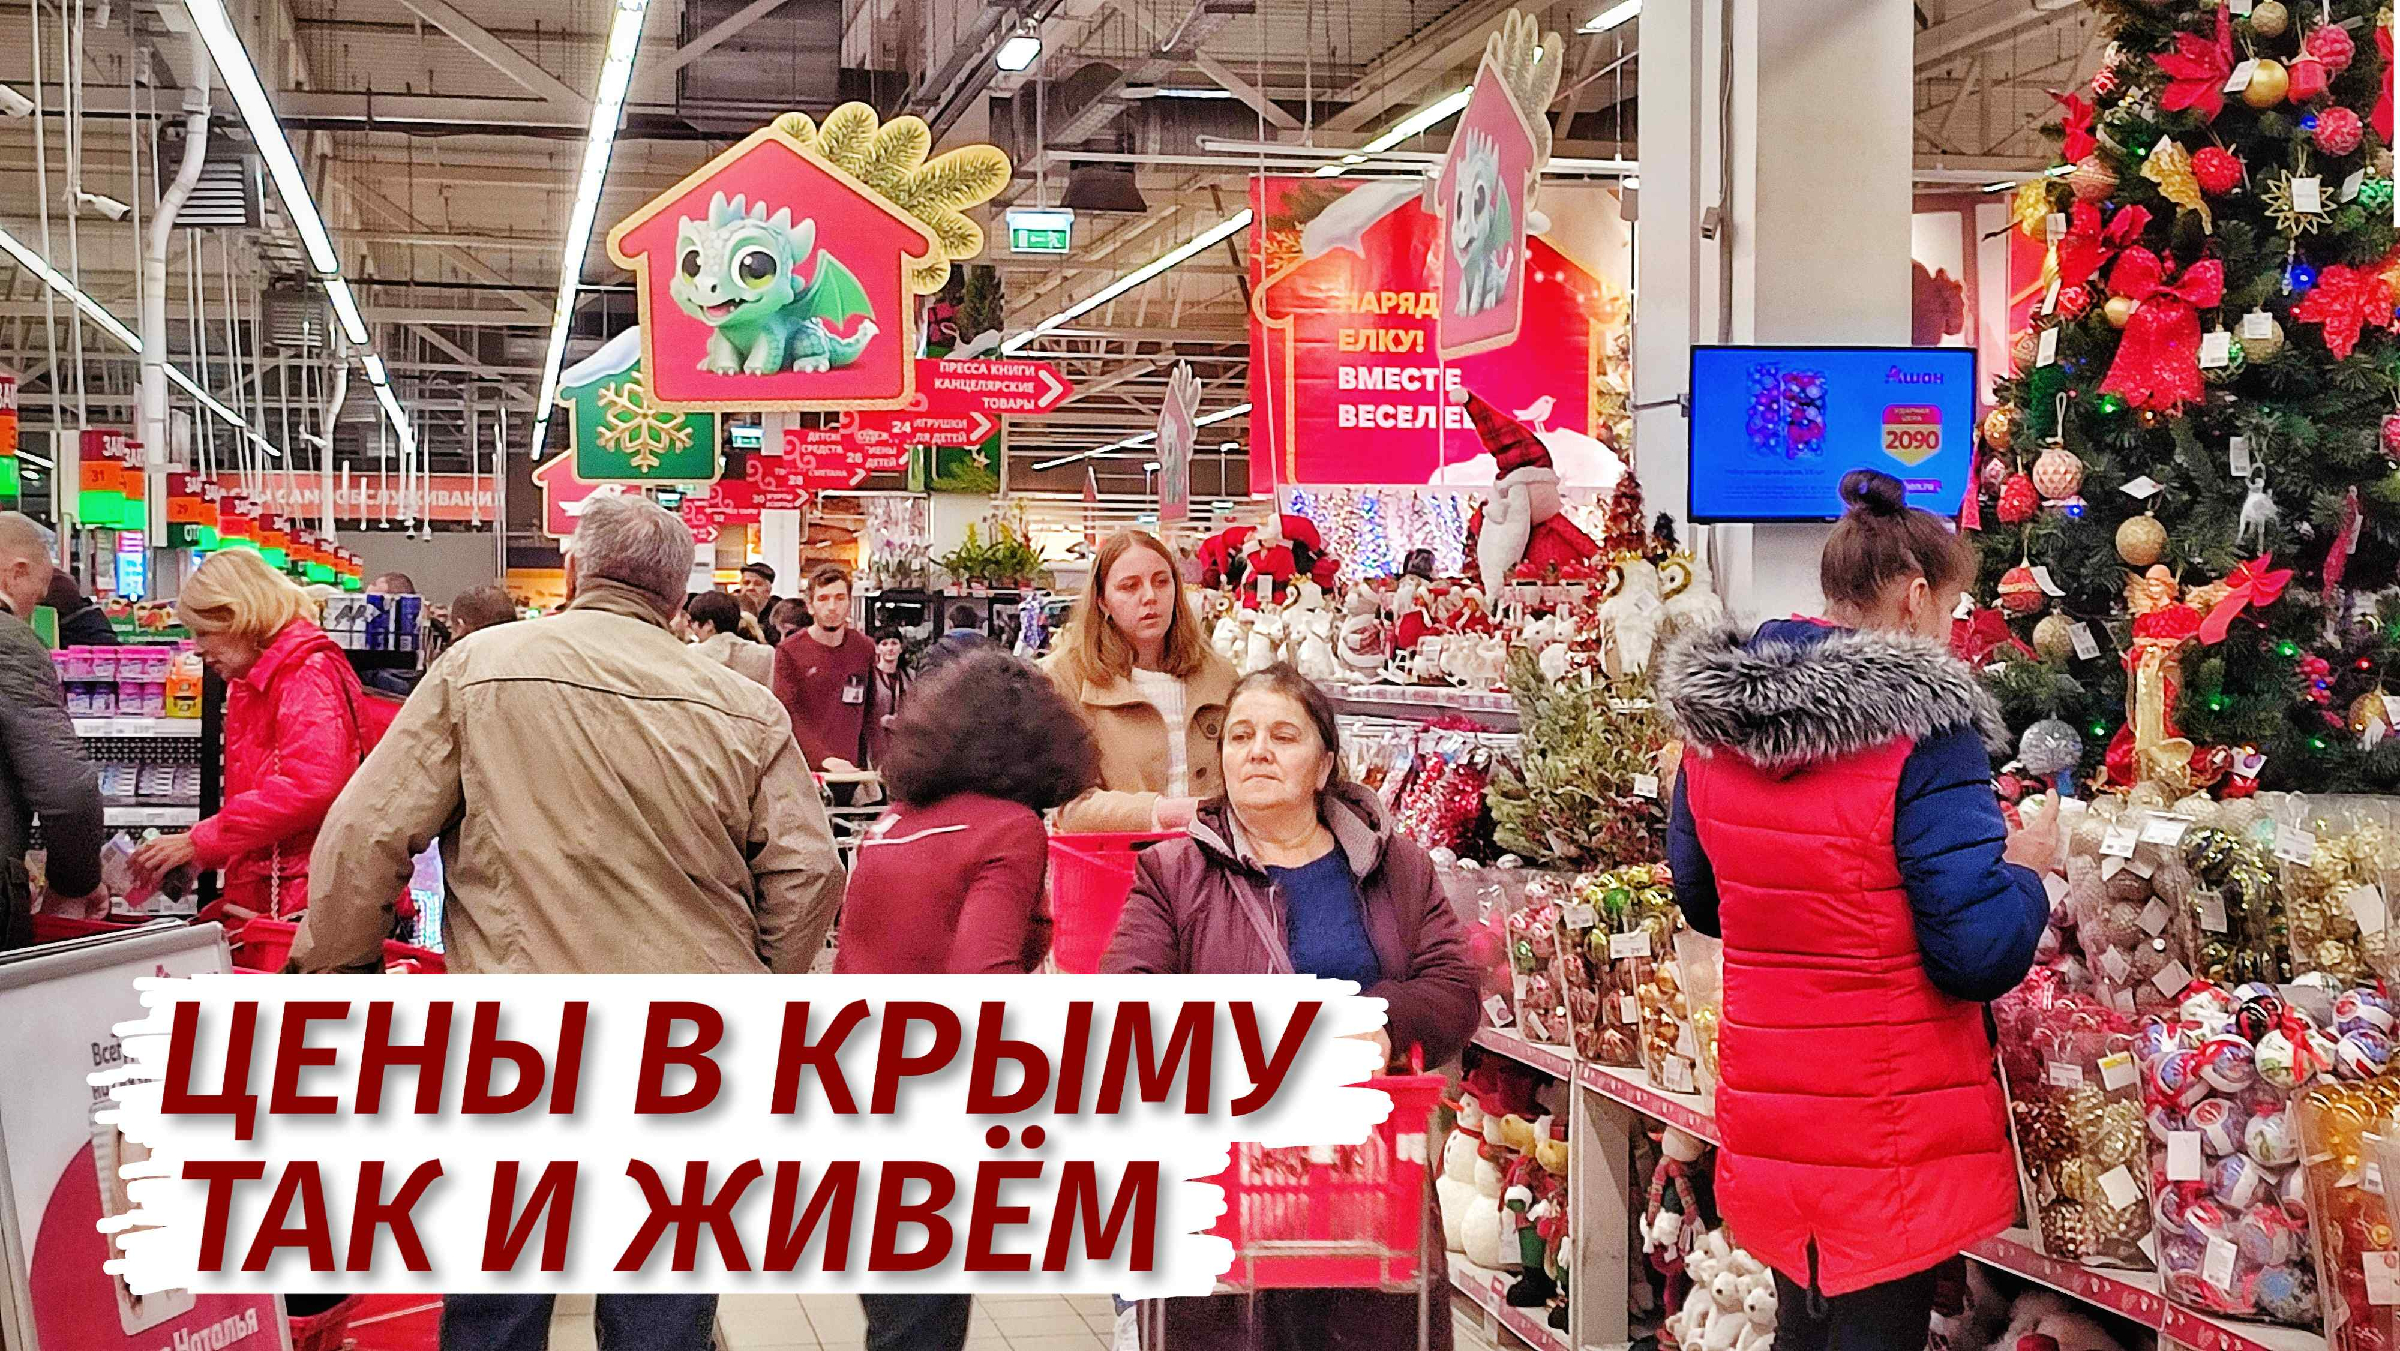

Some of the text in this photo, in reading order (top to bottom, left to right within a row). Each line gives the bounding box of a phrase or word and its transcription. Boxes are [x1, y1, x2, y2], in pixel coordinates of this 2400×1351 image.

[1338, 328, 1425, 354] ЕЛКУ!
[940, 361, 1035, 377] ПРЕССА КНИГИ
[934, 378, 1035, 393] КАНЦЕЛЯРСКИЕ
[1338, 366, 1463, 392] ВМЕСТЕ
[983, 397, 1035, 410] ТОВАРЫ
[1885, 430, 1940, 450] 2090
